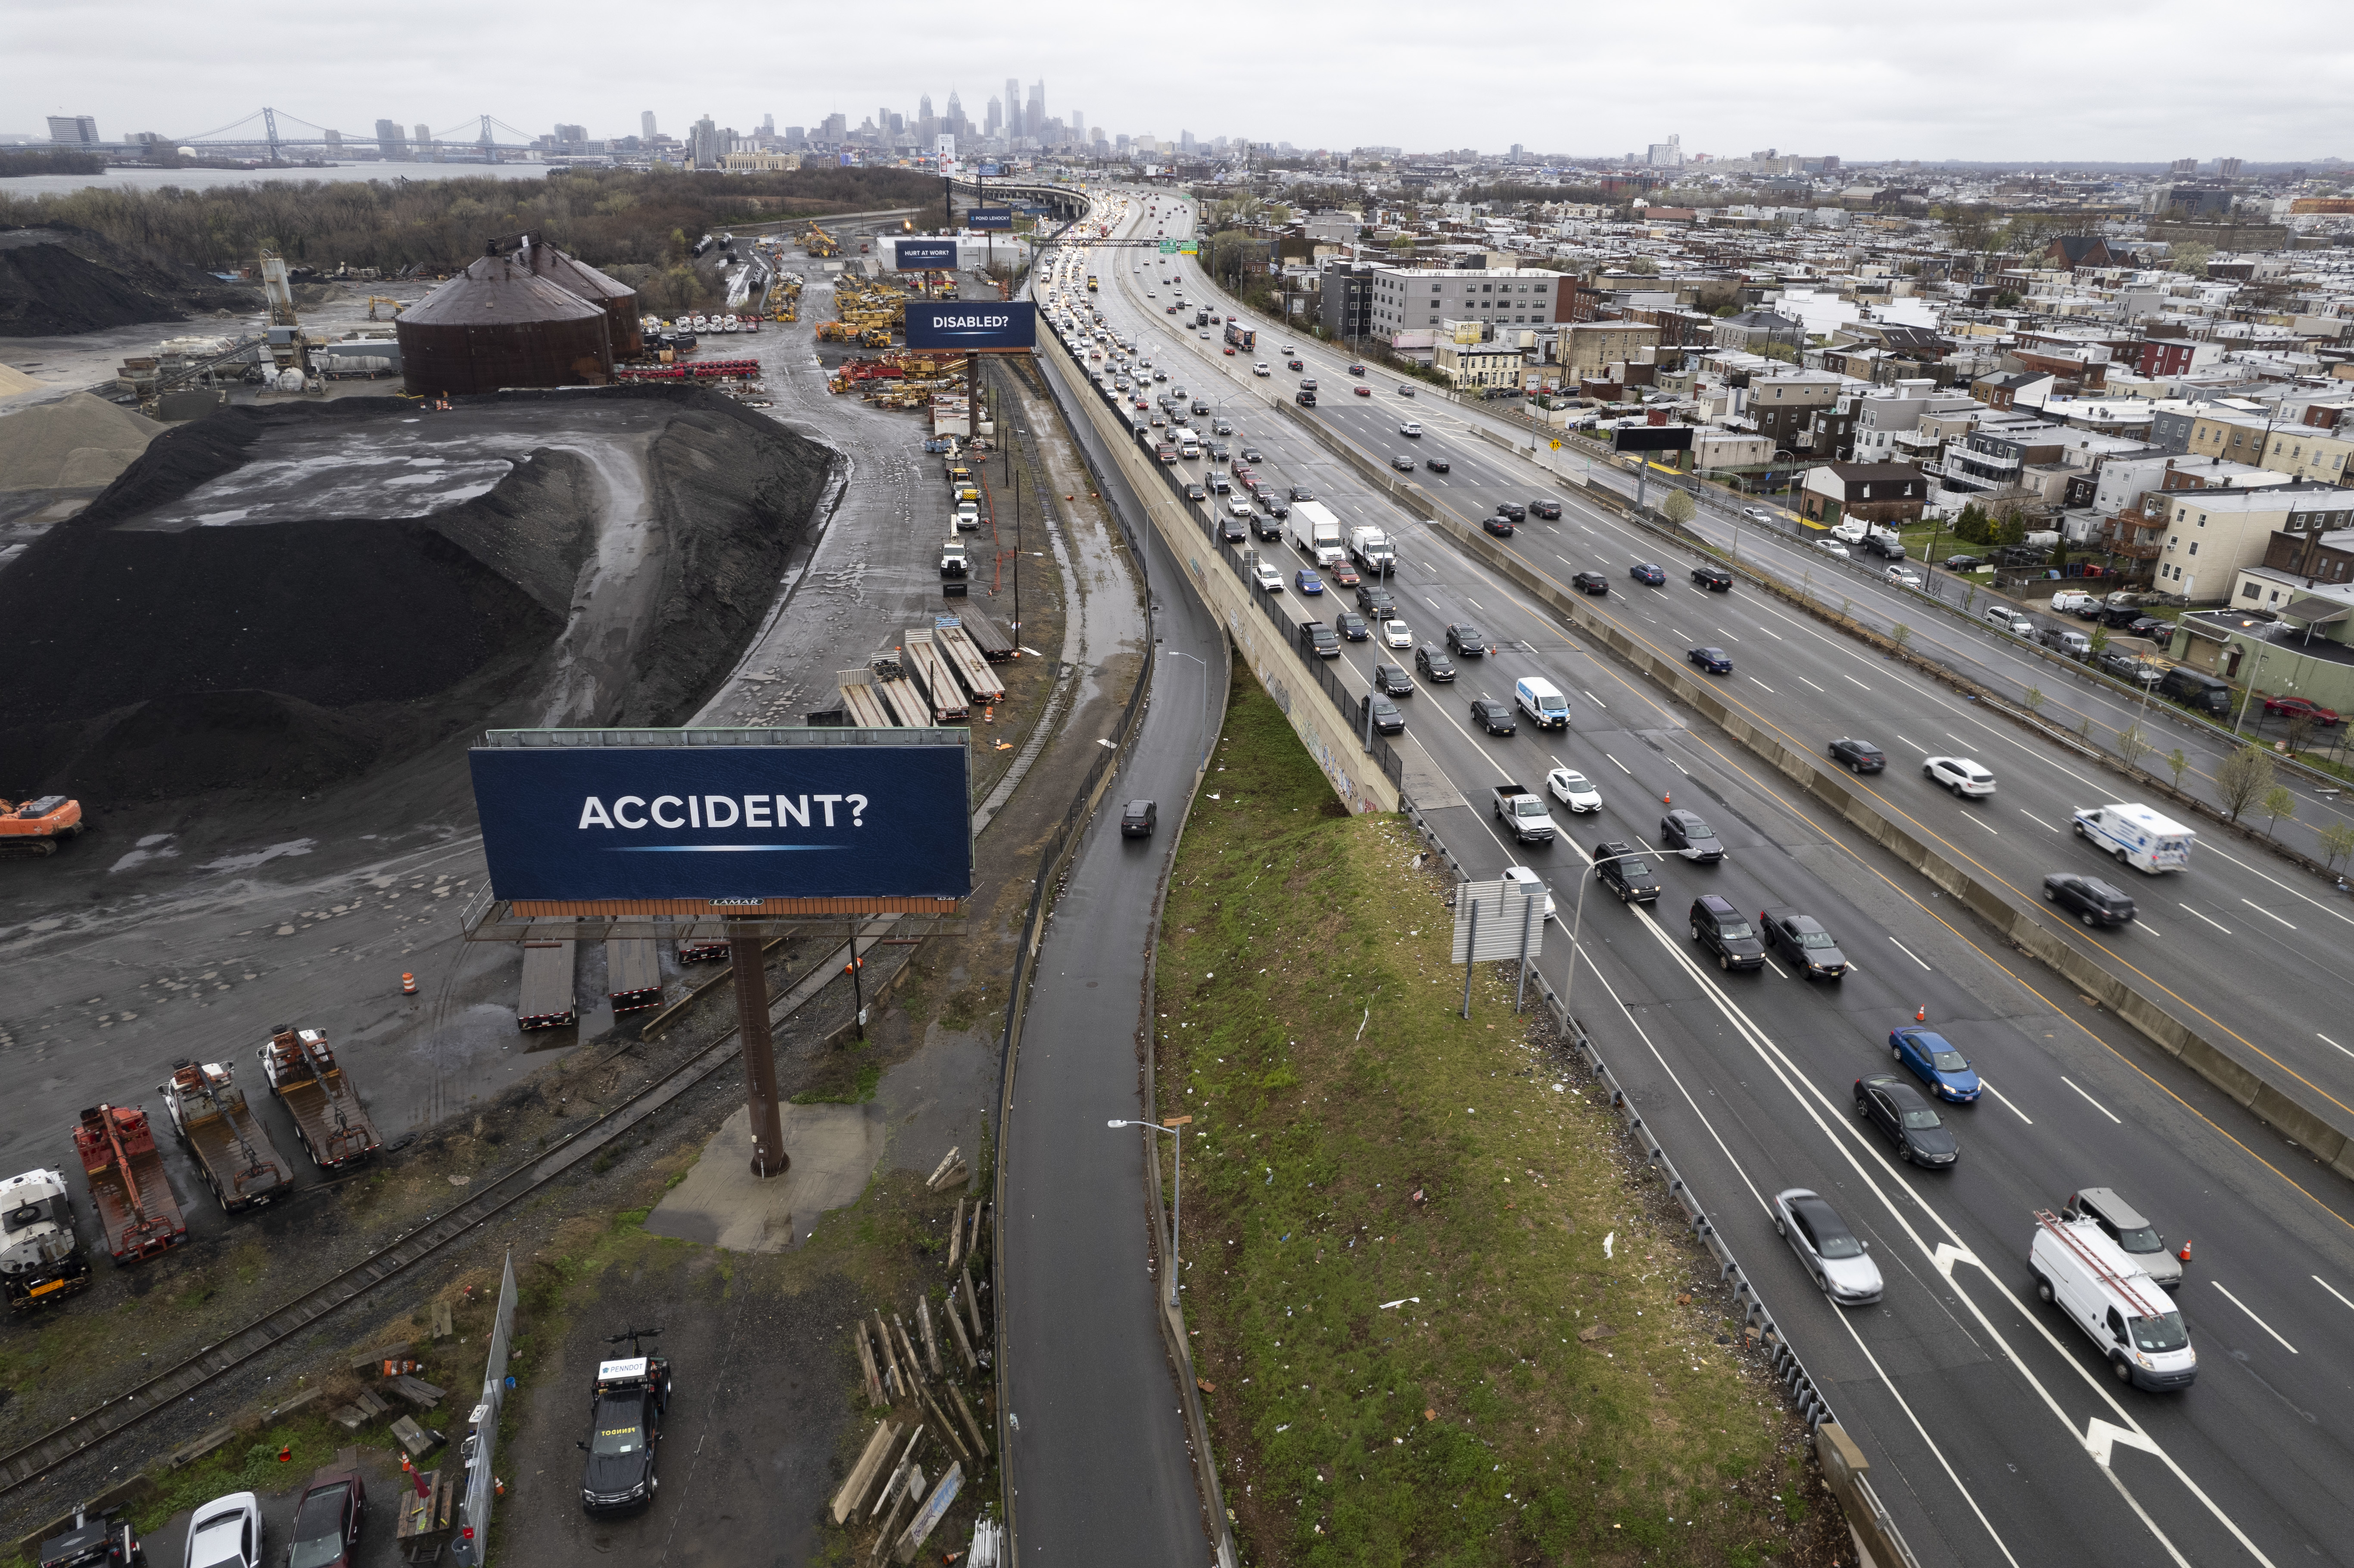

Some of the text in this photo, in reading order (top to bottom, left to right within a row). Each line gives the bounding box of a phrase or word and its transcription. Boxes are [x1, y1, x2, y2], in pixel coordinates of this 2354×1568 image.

[933, 316, 1009, 328] DISABLED?
[578, 793, 868, 830] ACCIDENT?
[610, 1363, 643, 1372] PENNDOT
